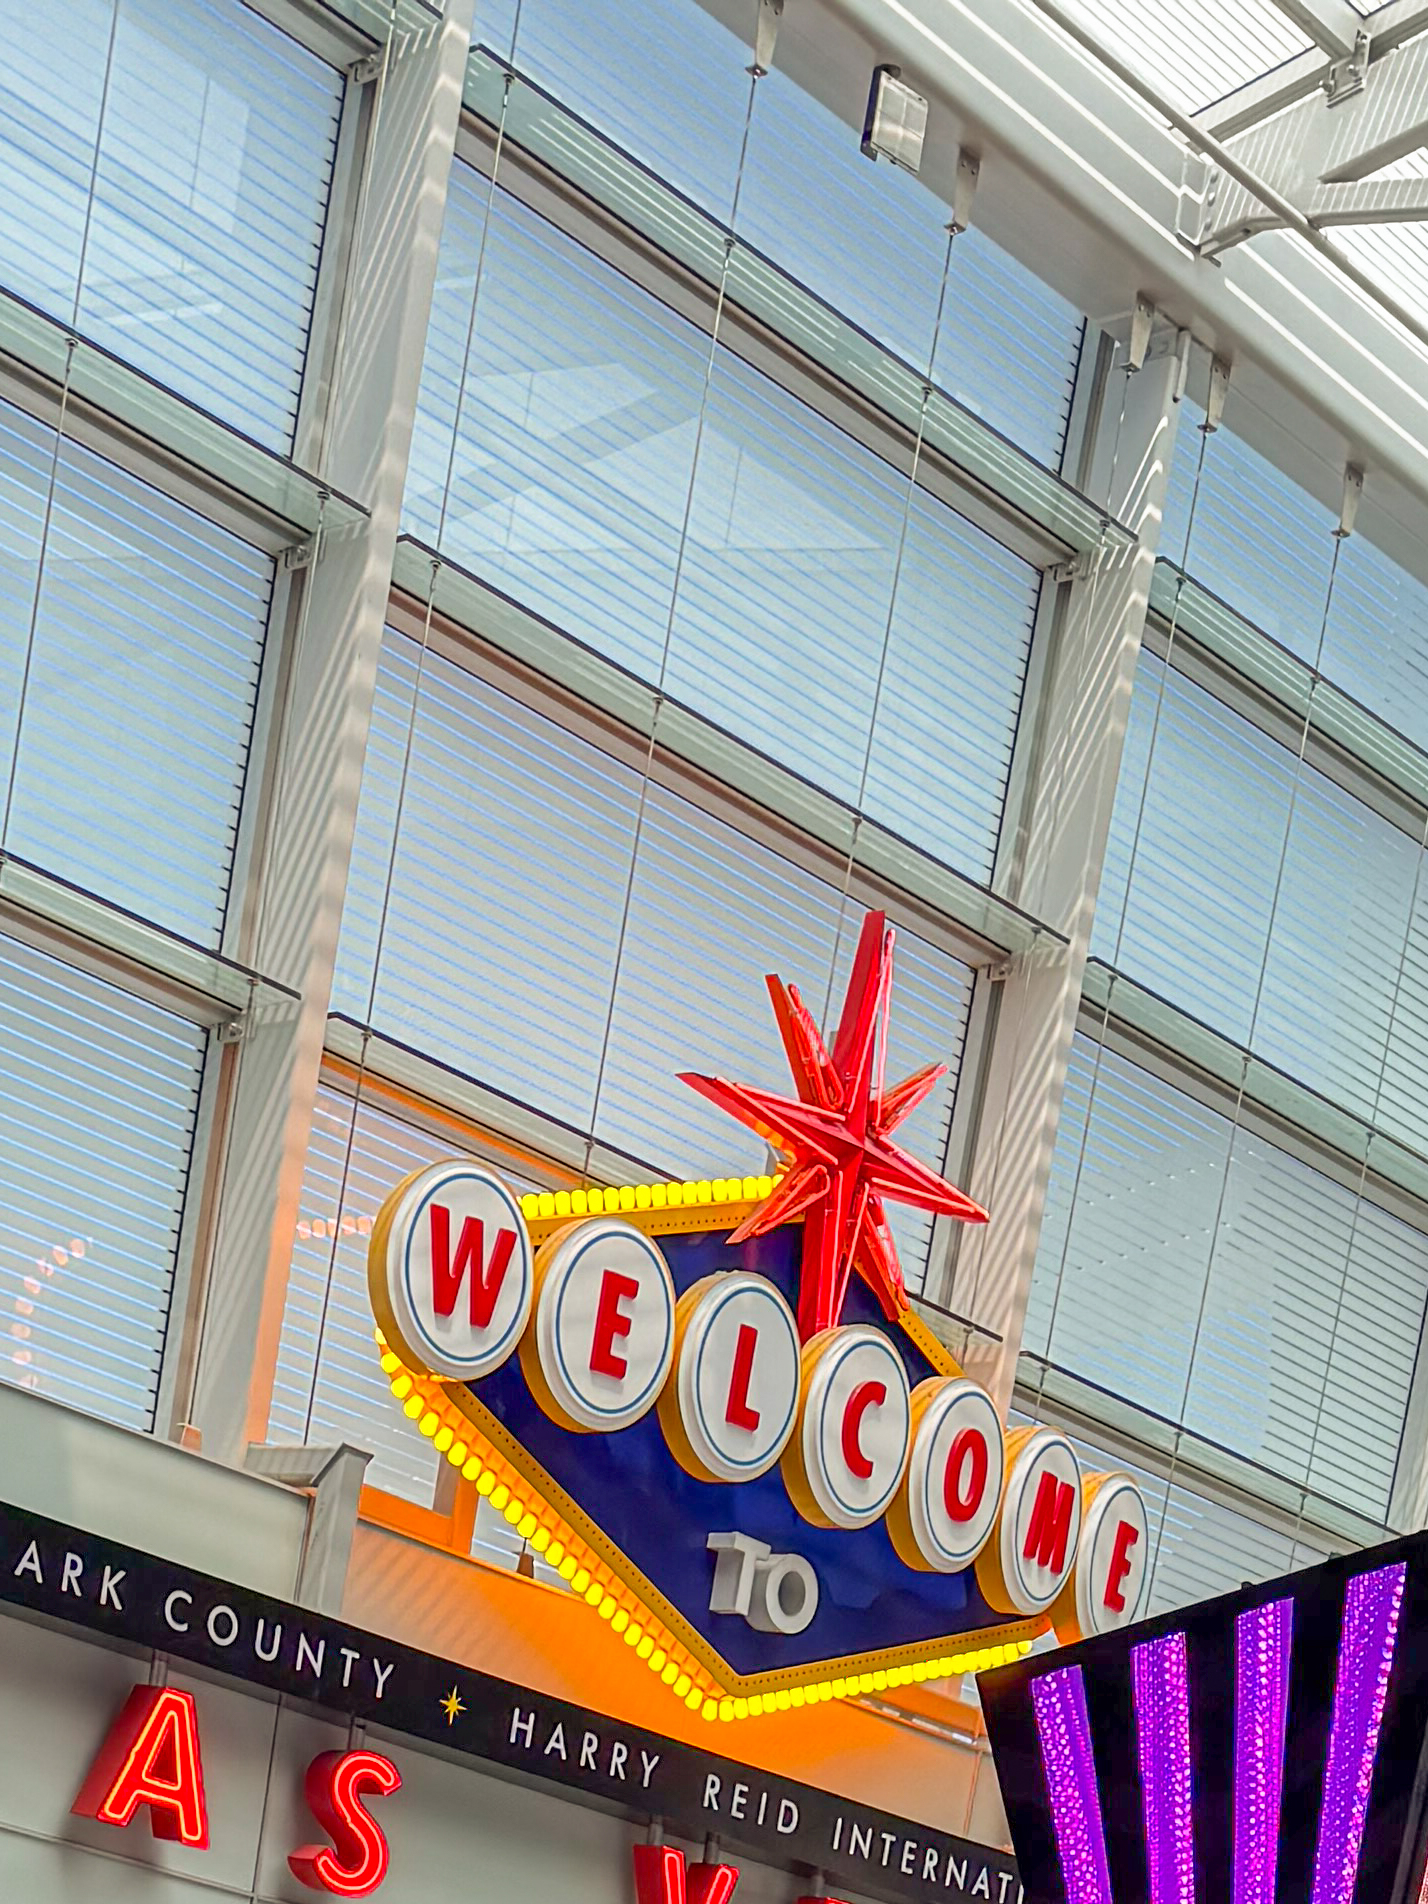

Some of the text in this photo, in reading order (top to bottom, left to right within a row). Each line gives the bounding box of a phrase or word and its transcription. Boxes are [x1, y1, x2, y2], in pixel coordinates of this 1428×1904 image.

[429, 1203, 1139, 1613] WELCOME
[706, 1530, 819, 1634] TO
[164, 1590, 395, 1698] COUNTY
[509, 1707, 664, 1788] HARRY
[702, 1773, 800, 1834] REID
